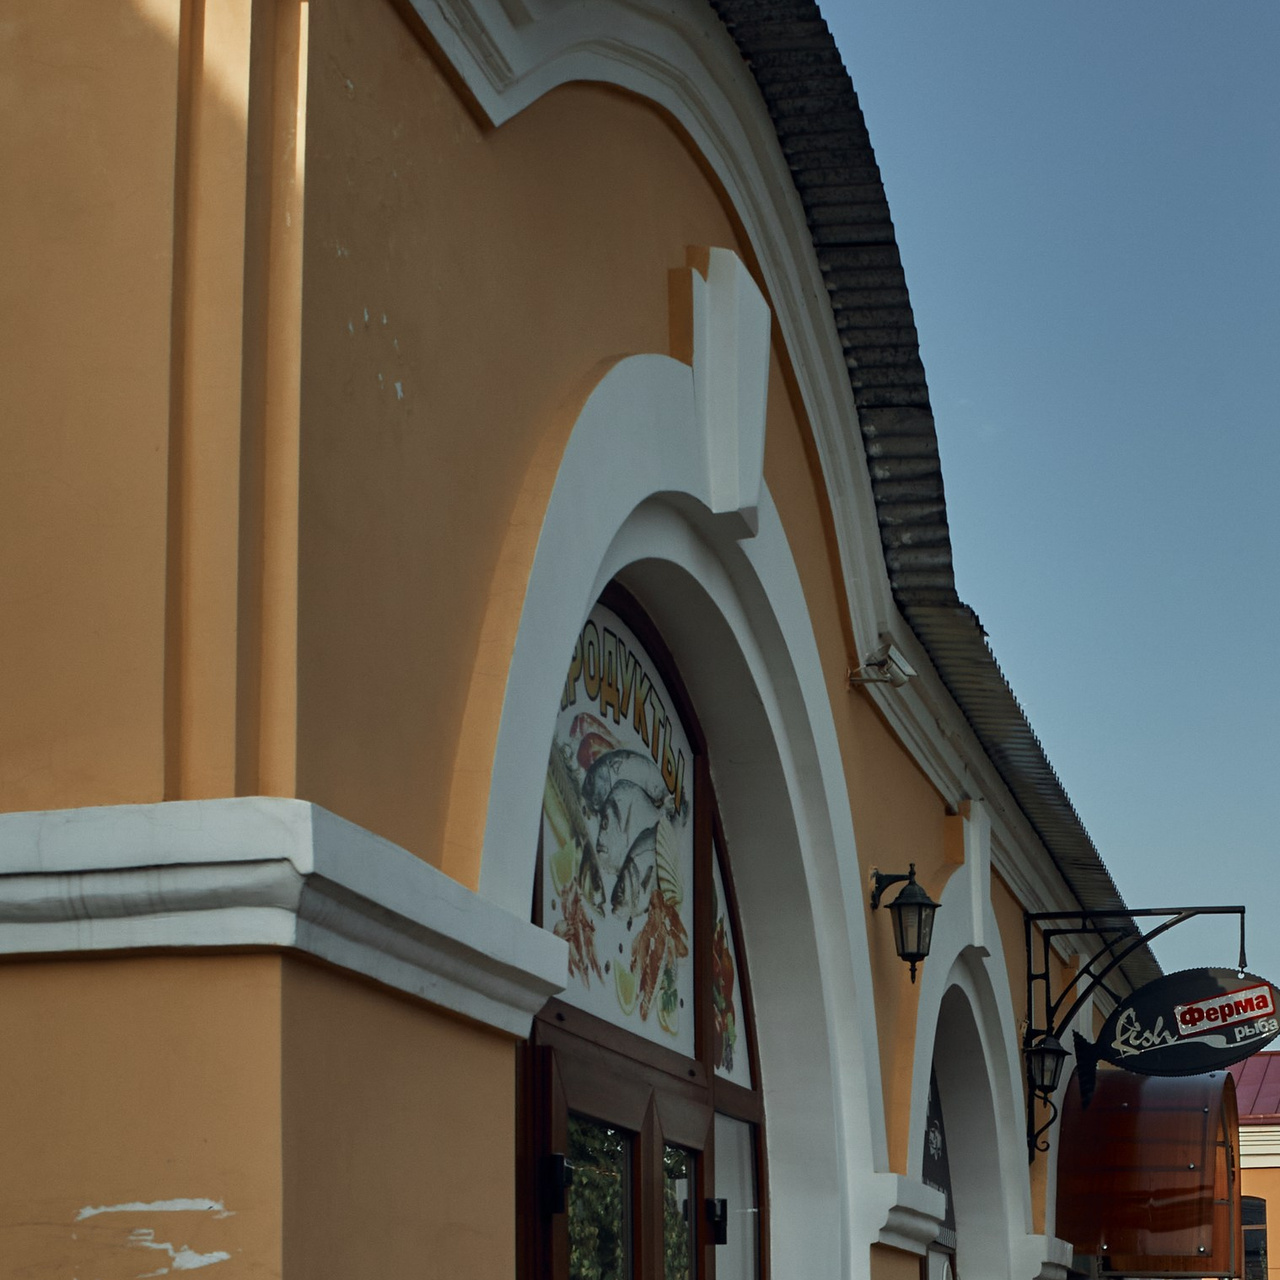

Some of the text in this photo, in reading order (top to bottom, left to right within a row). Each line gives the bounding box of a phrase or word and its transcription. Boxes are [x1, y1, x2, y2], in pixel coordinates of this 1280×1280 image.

[561, 619, 685, 815] РОДУКТЫ
[1179, 993, 1269, 1027] Ферма
[1234, 1017, 1279, 1042] рыба
